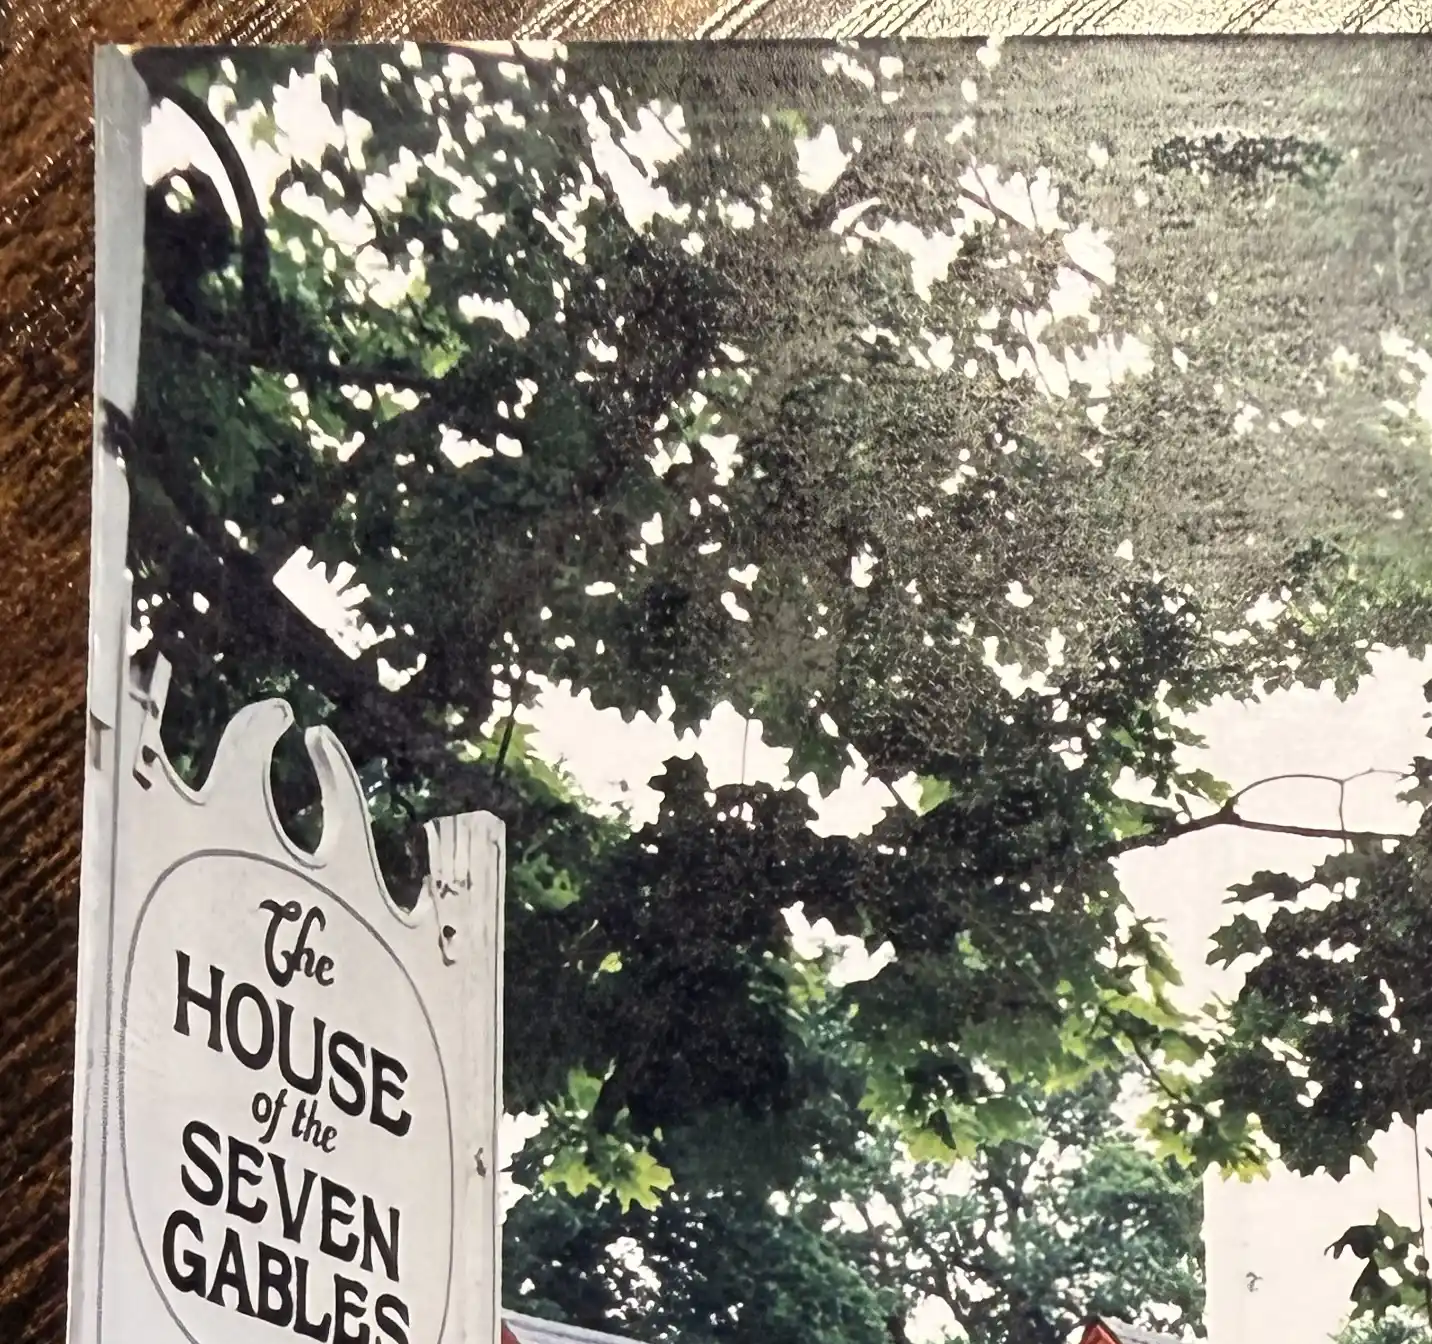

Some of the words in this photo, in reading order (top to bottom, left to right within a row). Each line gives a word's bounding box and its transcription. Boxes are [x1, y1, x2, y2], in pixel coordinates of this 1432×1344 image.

[258, 899, 335, 987] The
[173, 949, 412, 1138] HOUSE
[251, 1088, 288, 1144] of
[291, 1099, 338, 1153] the
[180, 1120, 400, 1282] SEVEN
